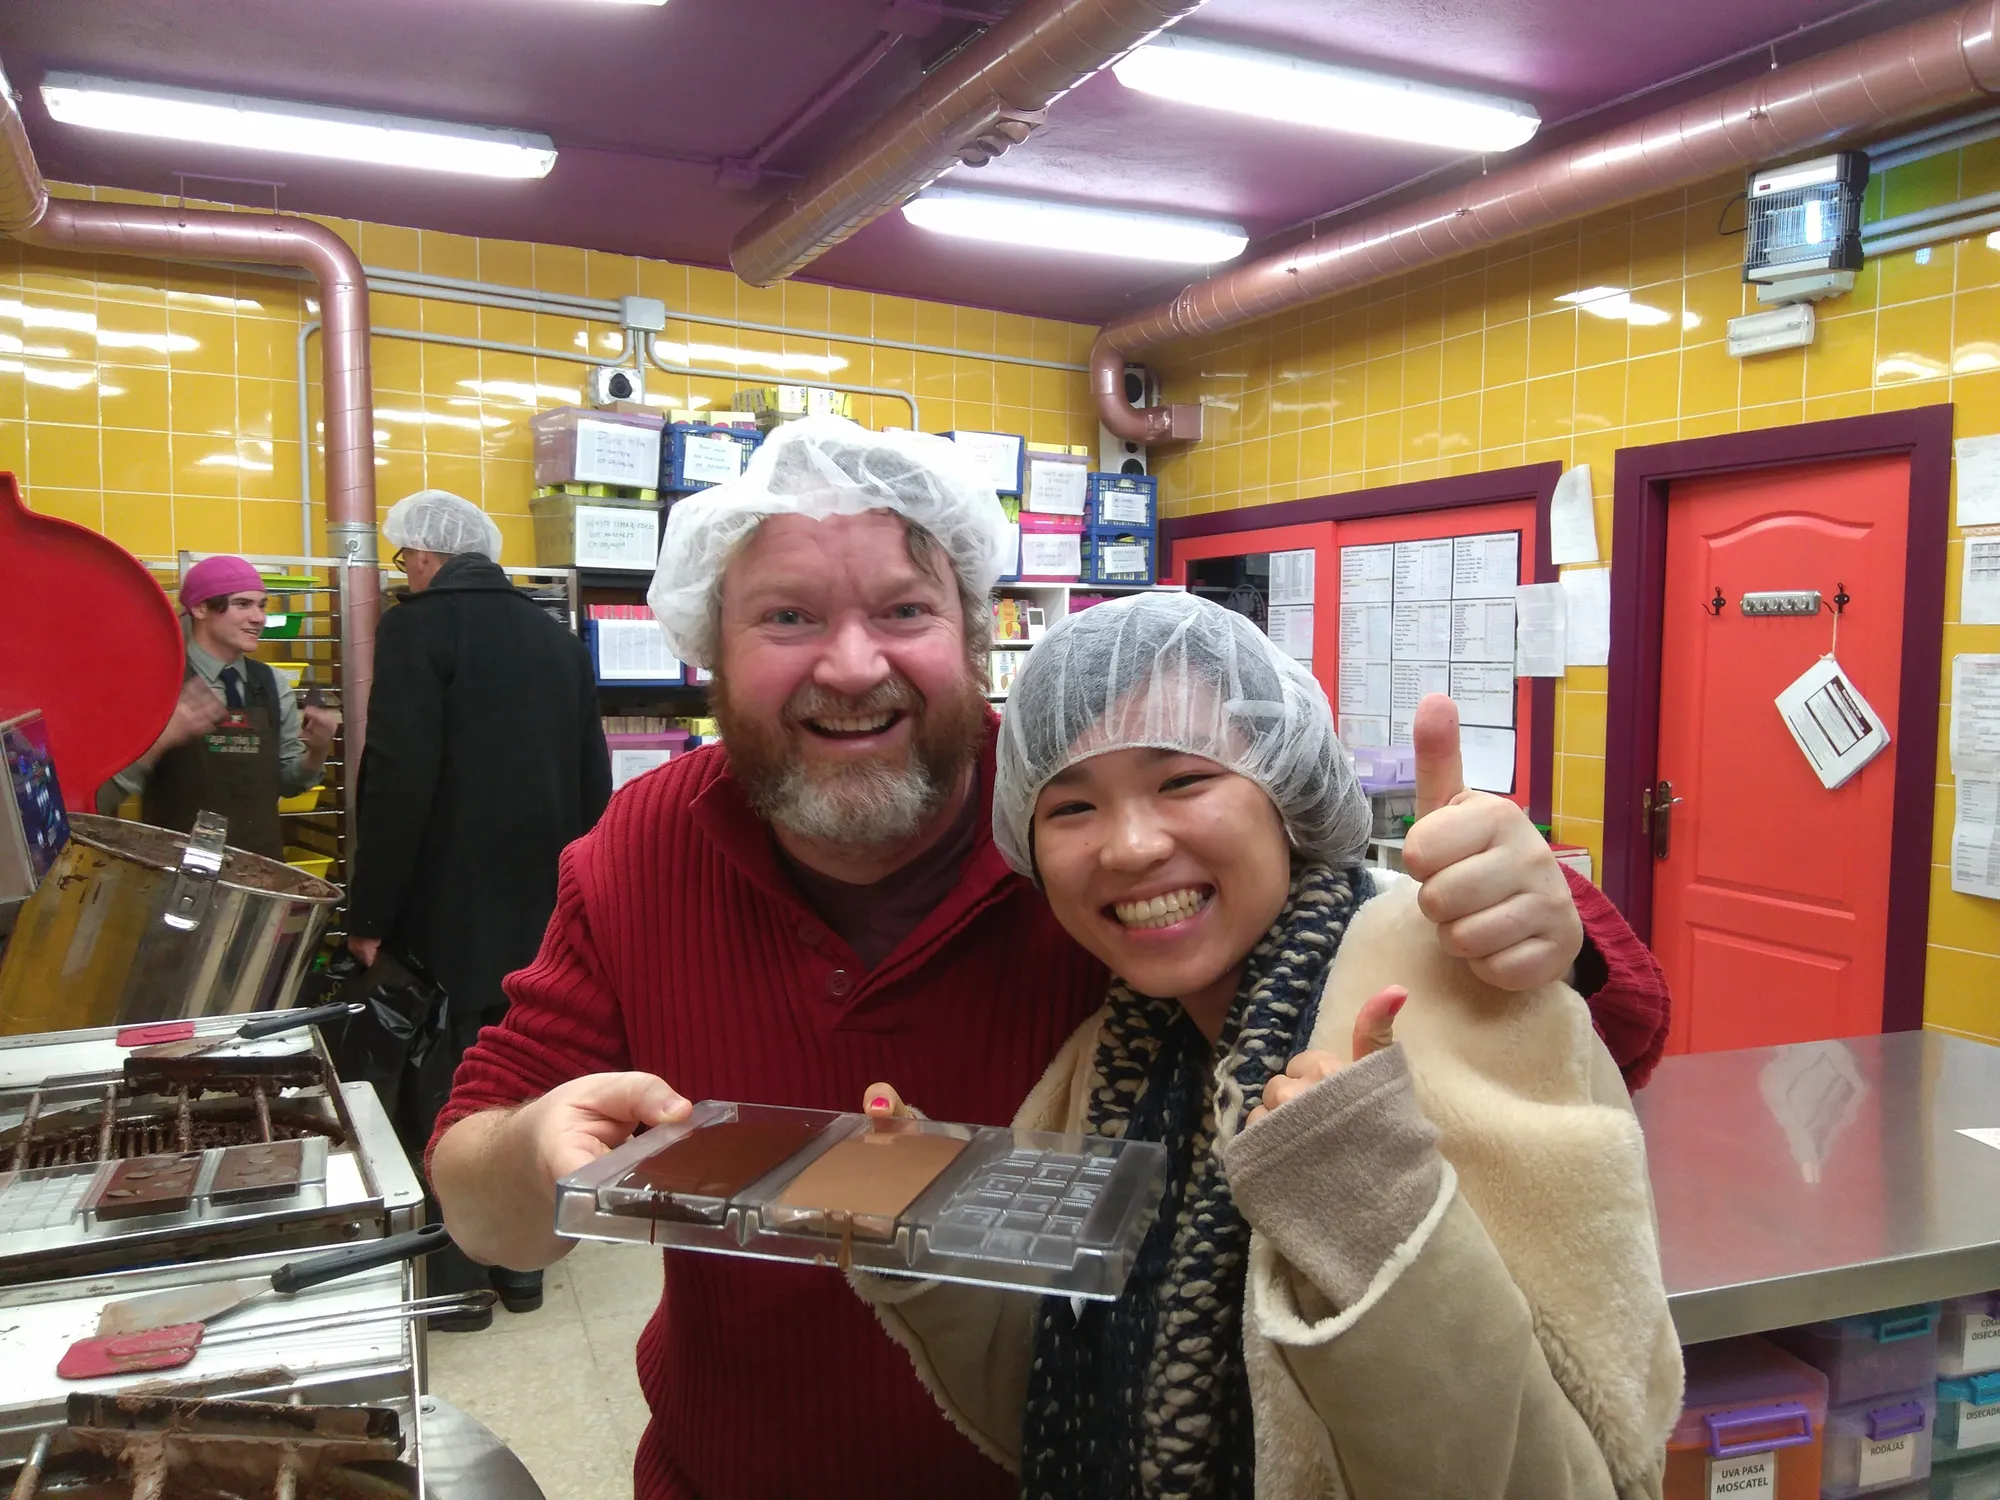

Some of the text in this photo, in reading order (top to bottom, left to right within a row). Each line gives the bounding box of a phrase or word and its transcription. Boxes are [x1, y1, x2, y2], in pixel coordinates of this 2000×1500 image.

[1870, 1441, 1905, 1456] RODAJAS
[1721, 1463, 1765, 1479] UVA PASA
[1716, 1476, 1769, 1494] MOSCATEL
